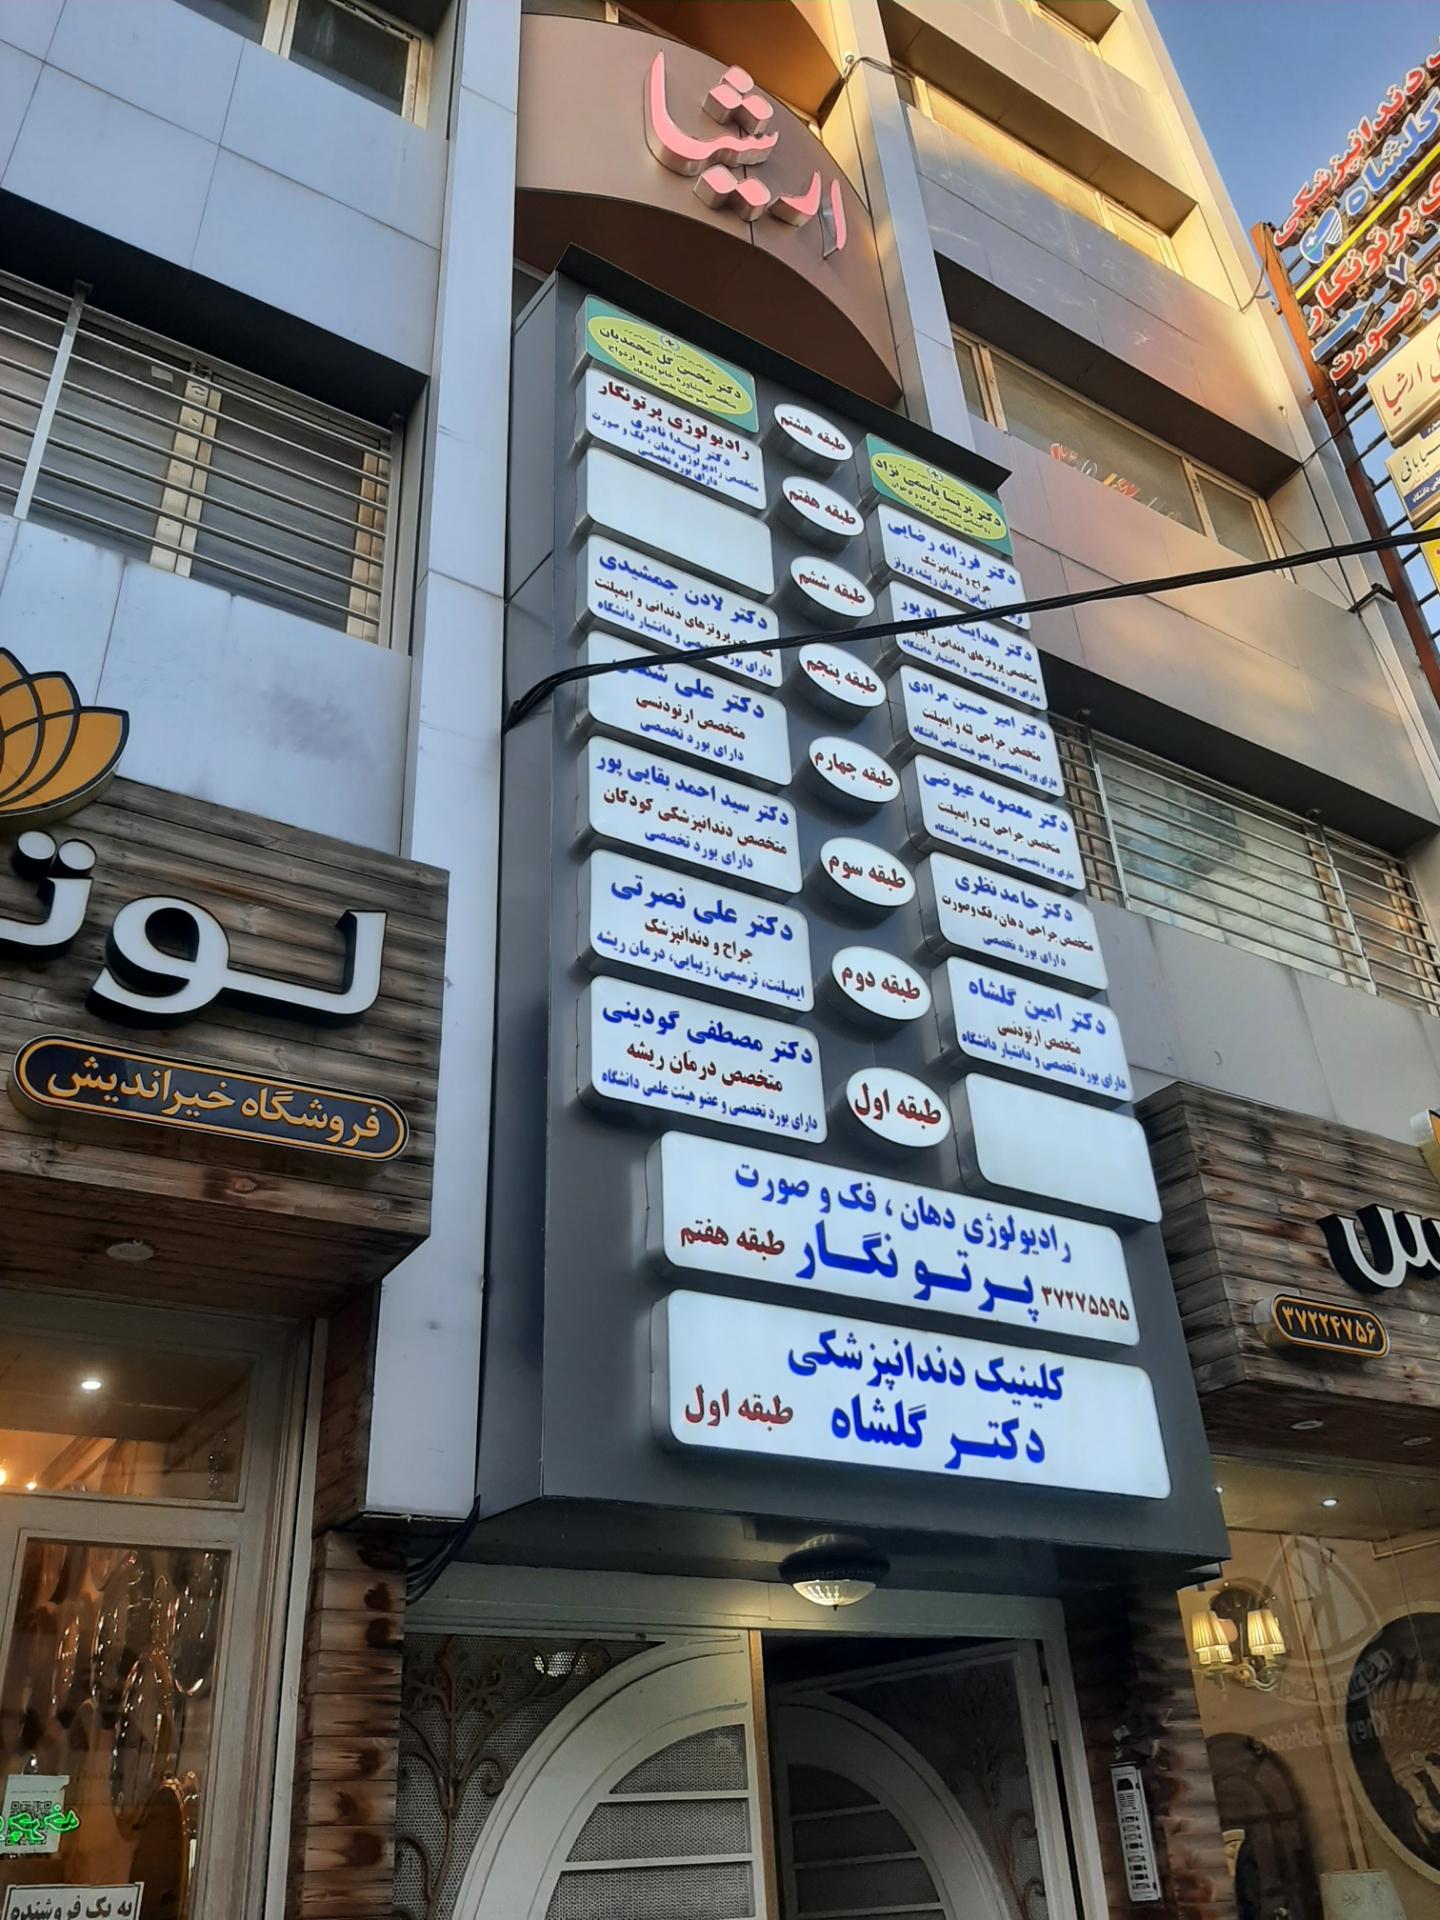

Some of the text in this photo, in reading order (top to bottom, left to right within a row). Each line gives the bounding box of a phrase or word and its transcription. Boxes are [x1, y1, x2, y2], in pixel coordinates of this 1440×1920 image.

[781, 416, 845, 451] طبقه هشتم
[789, 489, 856, 525] طبقه هفتم
[599, 555, 768, 630] دکتر لادن جمشیدی
[799, 571, 865, 604] طبقه ششم
[675, 678, 765, 719] دکتر علی
[806, 657, 877, 694] طبقه پنجم
[597, 755, 789, 826] دکتر سید احمد بقایی پور
[815, 750, 893, 789] طبقه چهارم
[603, 787, 787, 855] متخصص دندانپزشکی کودکان
[829, 855, 906, 891] طبقه سوم
[610, 875, 793, 941] دکتر علی نصرتی
[955, 875, 1073, 922] دکتر حامد نظری
[644, 918, 753, 964] جراح و دندانپزشک
[842, 966, 921, 1003] طبقه دوم
[968, 978, 1106, 1035] دکتر امین گلشاه
[602, 1001, 813, 1064] دکتر مصطفی گودینی
[627, 1040, 783, 1092] متخصص درمان ریشه
[47, 1055, 381, 1149] فروشگاه خیراندیش
[854, 1082, 942, 1130] طبقه اول
[735, 1162, 1072, 1263] رادیولوژی دهان فک و صورت
[680, 1220, 786, 1261] طبقه هفتم
[1041, 1285, 1130, 1320] ۳۷۲۷۵۵۹۵
[789, 1329, 1064, 1409] کلینیک دندانپزشکی
[684, 1385, 794, 1431] طبقه اول
[831, 1394, 1046, 1469] دکتر گلشاه
[86, 1896, 111, 1918] یک
[118, 1900, 132, 1916] به
